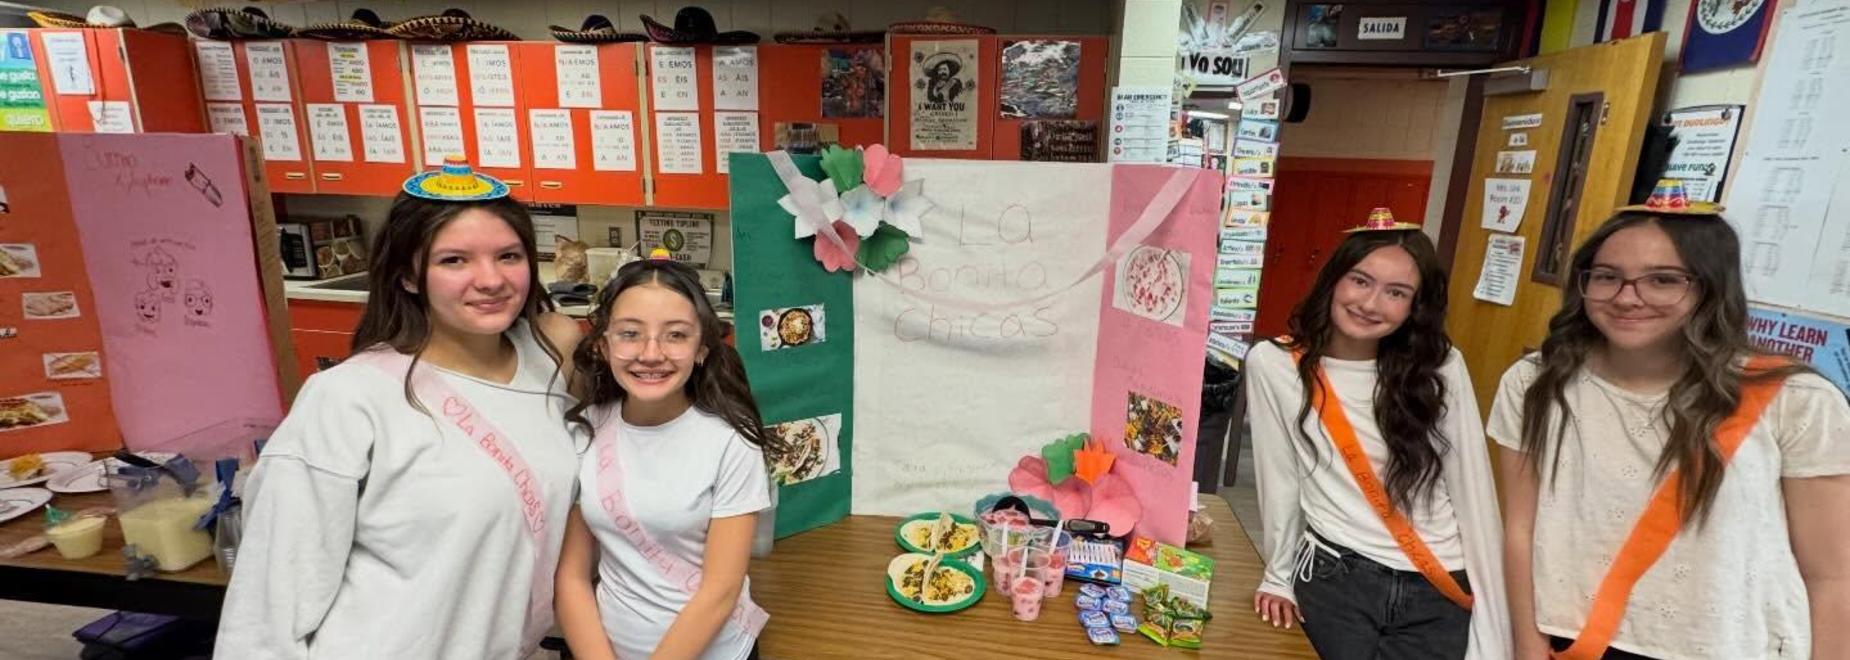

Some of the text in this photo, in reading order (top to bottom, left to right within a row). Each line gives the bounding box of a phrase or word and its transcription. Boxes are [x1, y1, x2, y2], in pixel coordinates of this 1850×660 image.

[1363, 20, 1400, 34] SALIDA
[949, 102, 966, 111] YOU
[1748, 316, 1829, 347] WHY LEARN
[1750, 335, 1815, 364] ANOTHER
